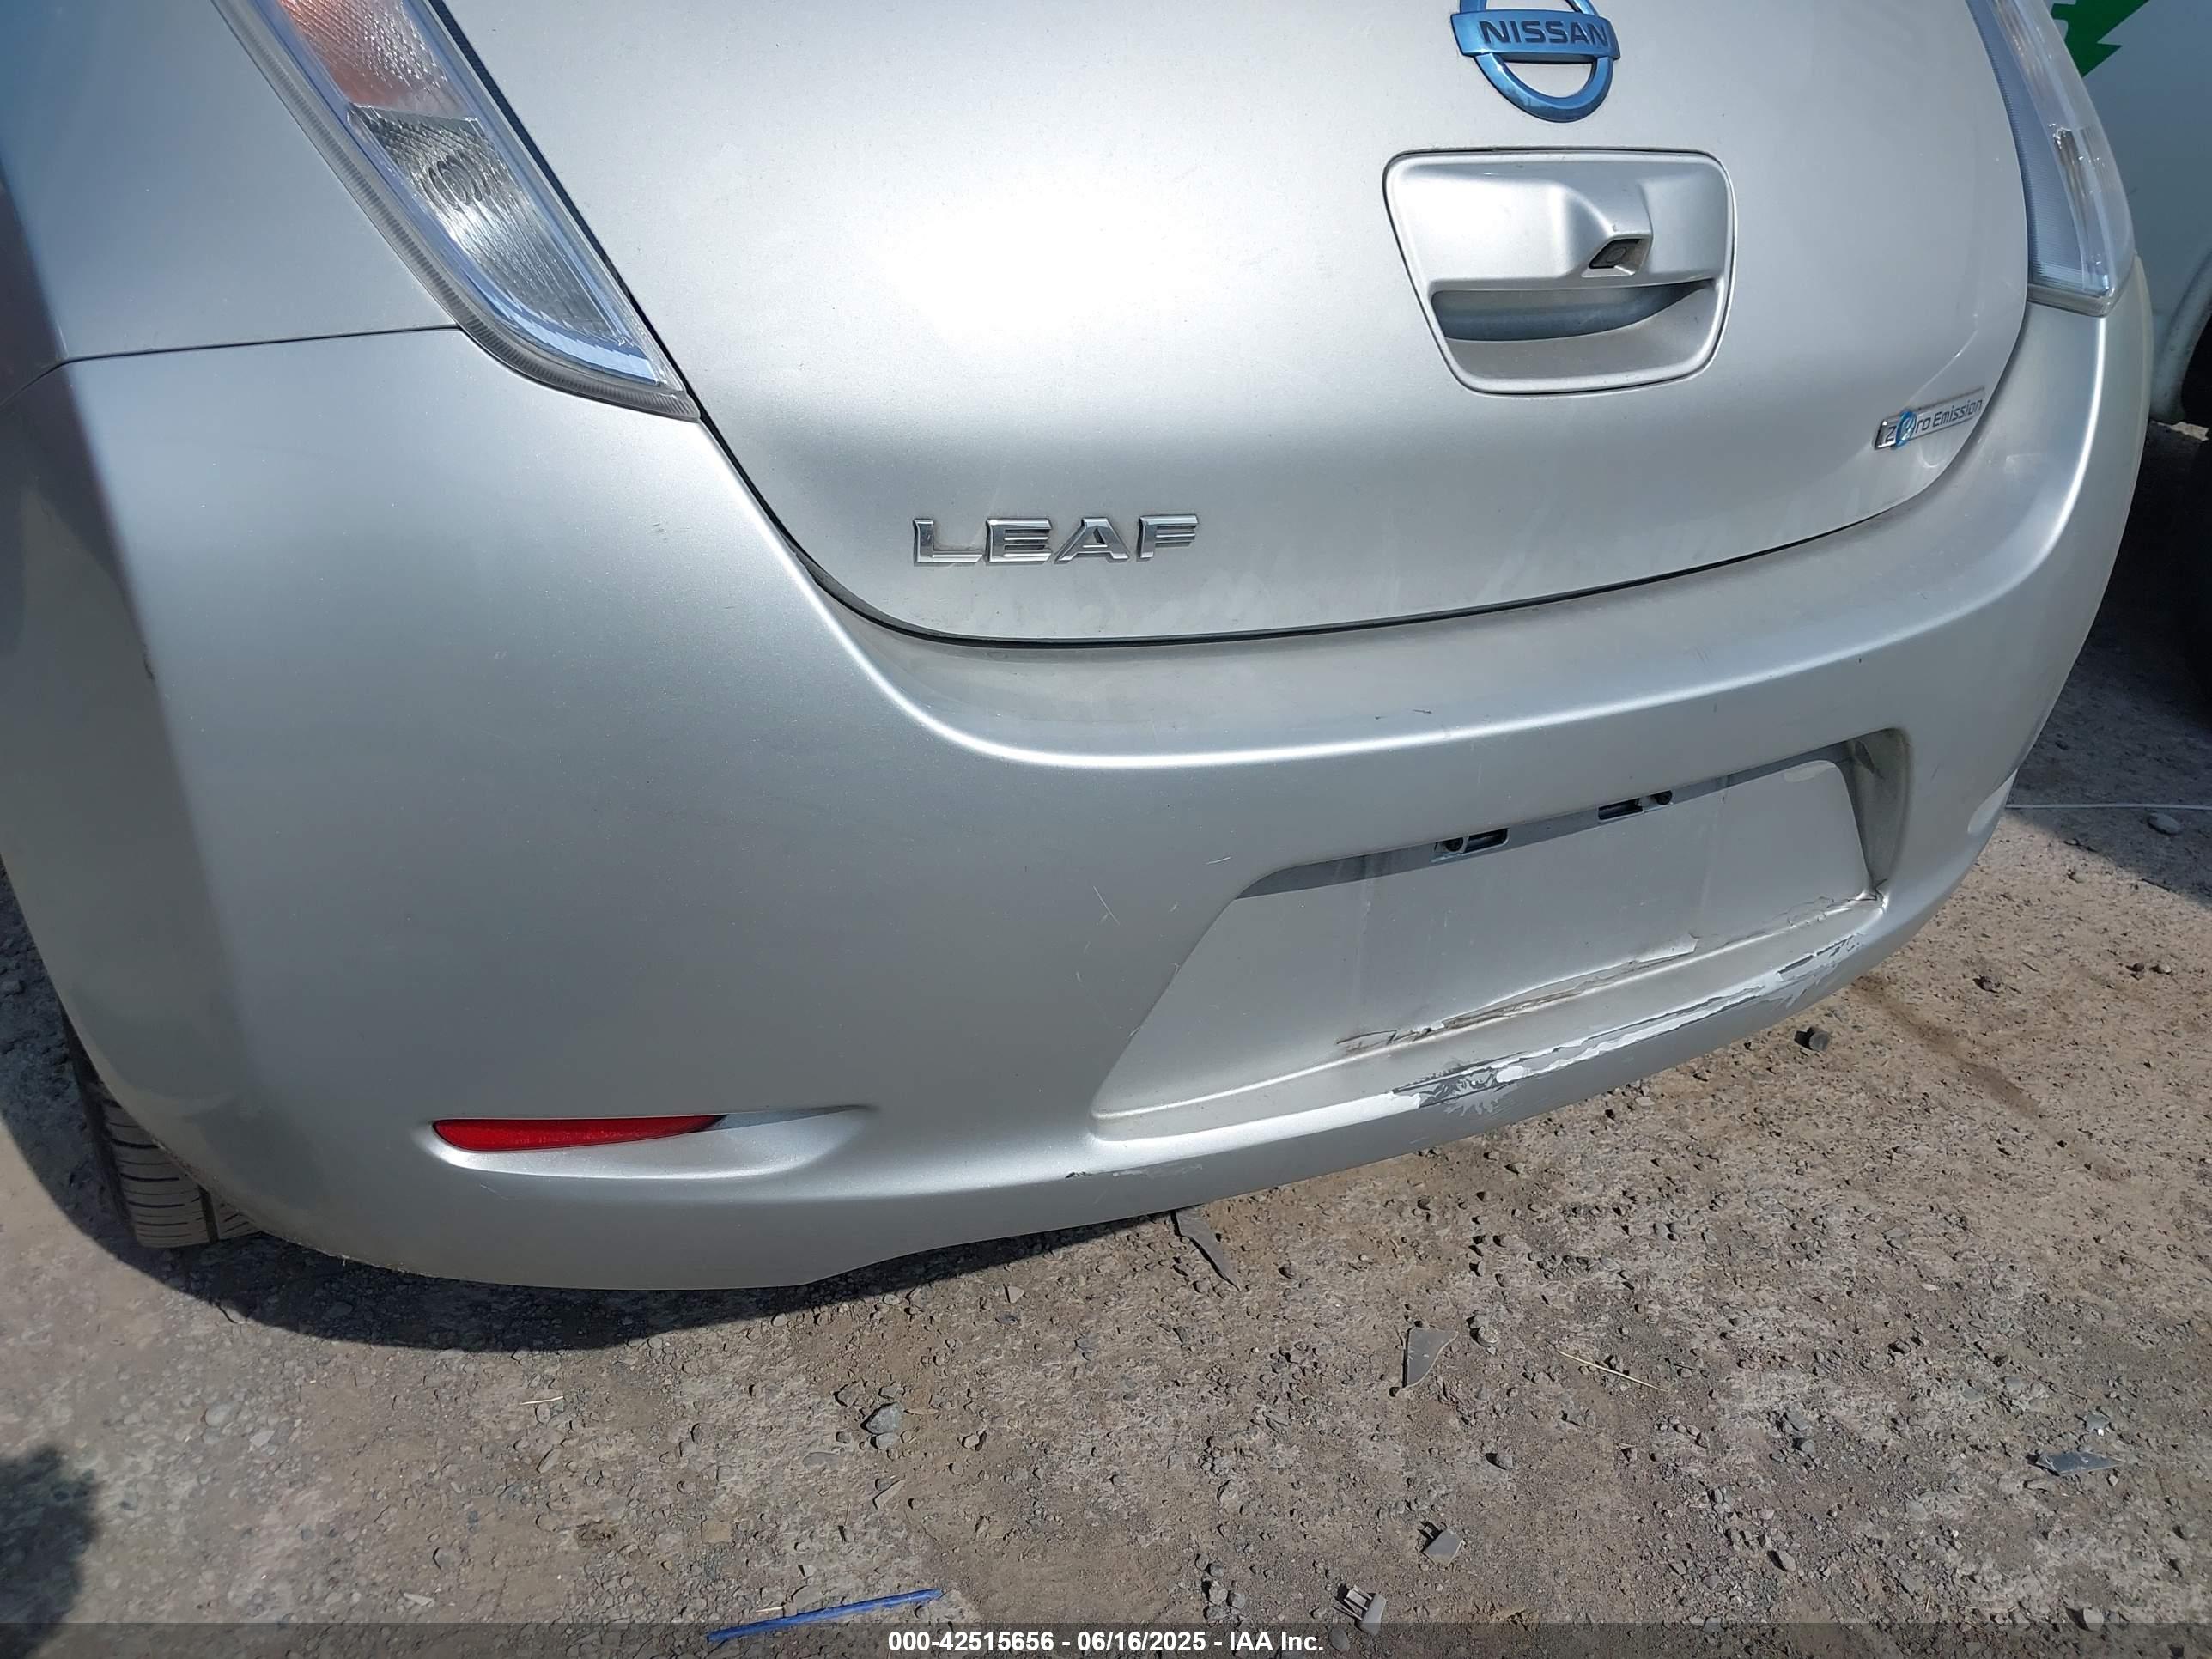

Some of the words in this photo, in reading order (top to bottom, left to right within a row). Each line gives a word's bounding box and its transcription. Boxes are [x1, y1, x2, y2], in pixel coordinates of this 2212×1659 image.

[1478, 20, 1609, 48] NISSAN
[1932, 398, 1984, 428] Emission
[913, 514, 1199, 565] LEAF
